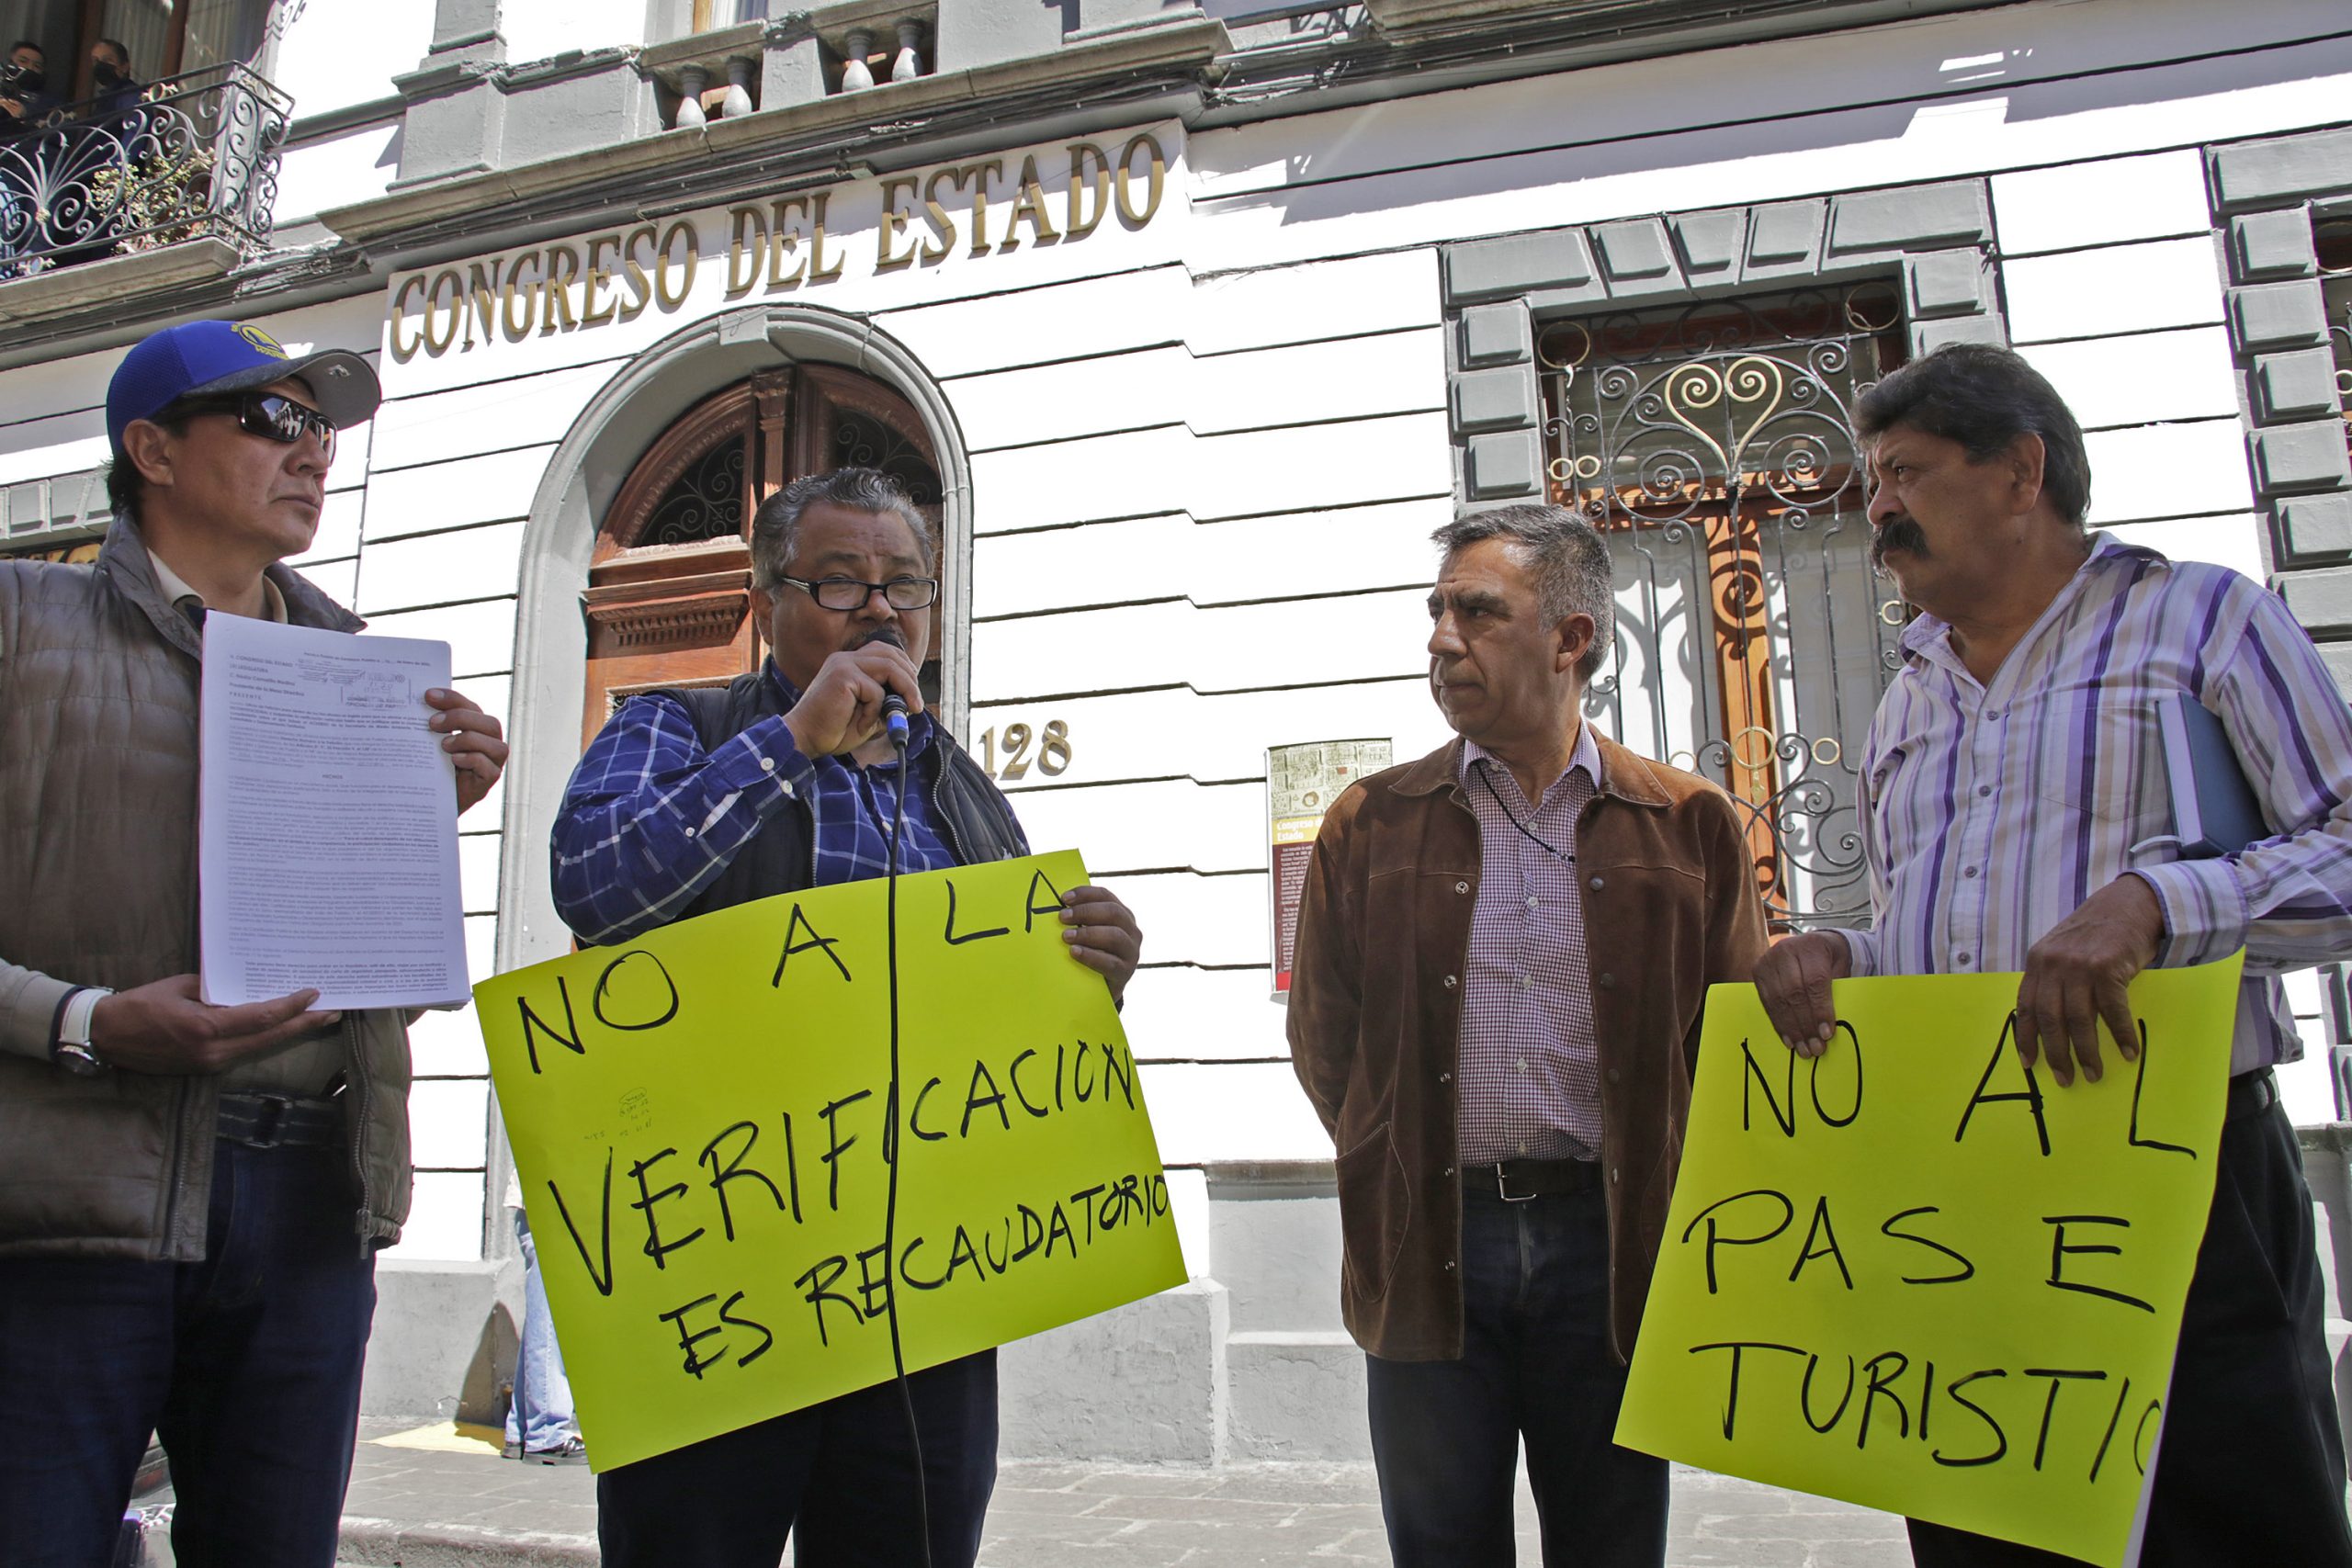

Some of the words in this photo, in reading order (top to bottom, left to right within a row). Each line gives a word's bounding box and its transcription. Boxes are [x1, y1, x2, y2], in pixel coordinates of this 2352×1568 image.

[390, 218, 699, 365] CONGRESO
[724, 190, 846, 302] DEL
[876, 132, 1166, 270] ESTADO
[978, 719, 1072, 779] 128
[518, 950, 680, 1075] NO
[773, 902, 852, 988] A
[945, 867, 1068, 945] LA
[548, 1038, 1136, 1297] VERIFICACION
[1740, 1020, 1863, 1138] NO
[659, 1291, 774, 1380] ES
[794, 1174, 1169, 1348] RECAUDATORIO
[1681, 1189, 2156, 1314] PASE
